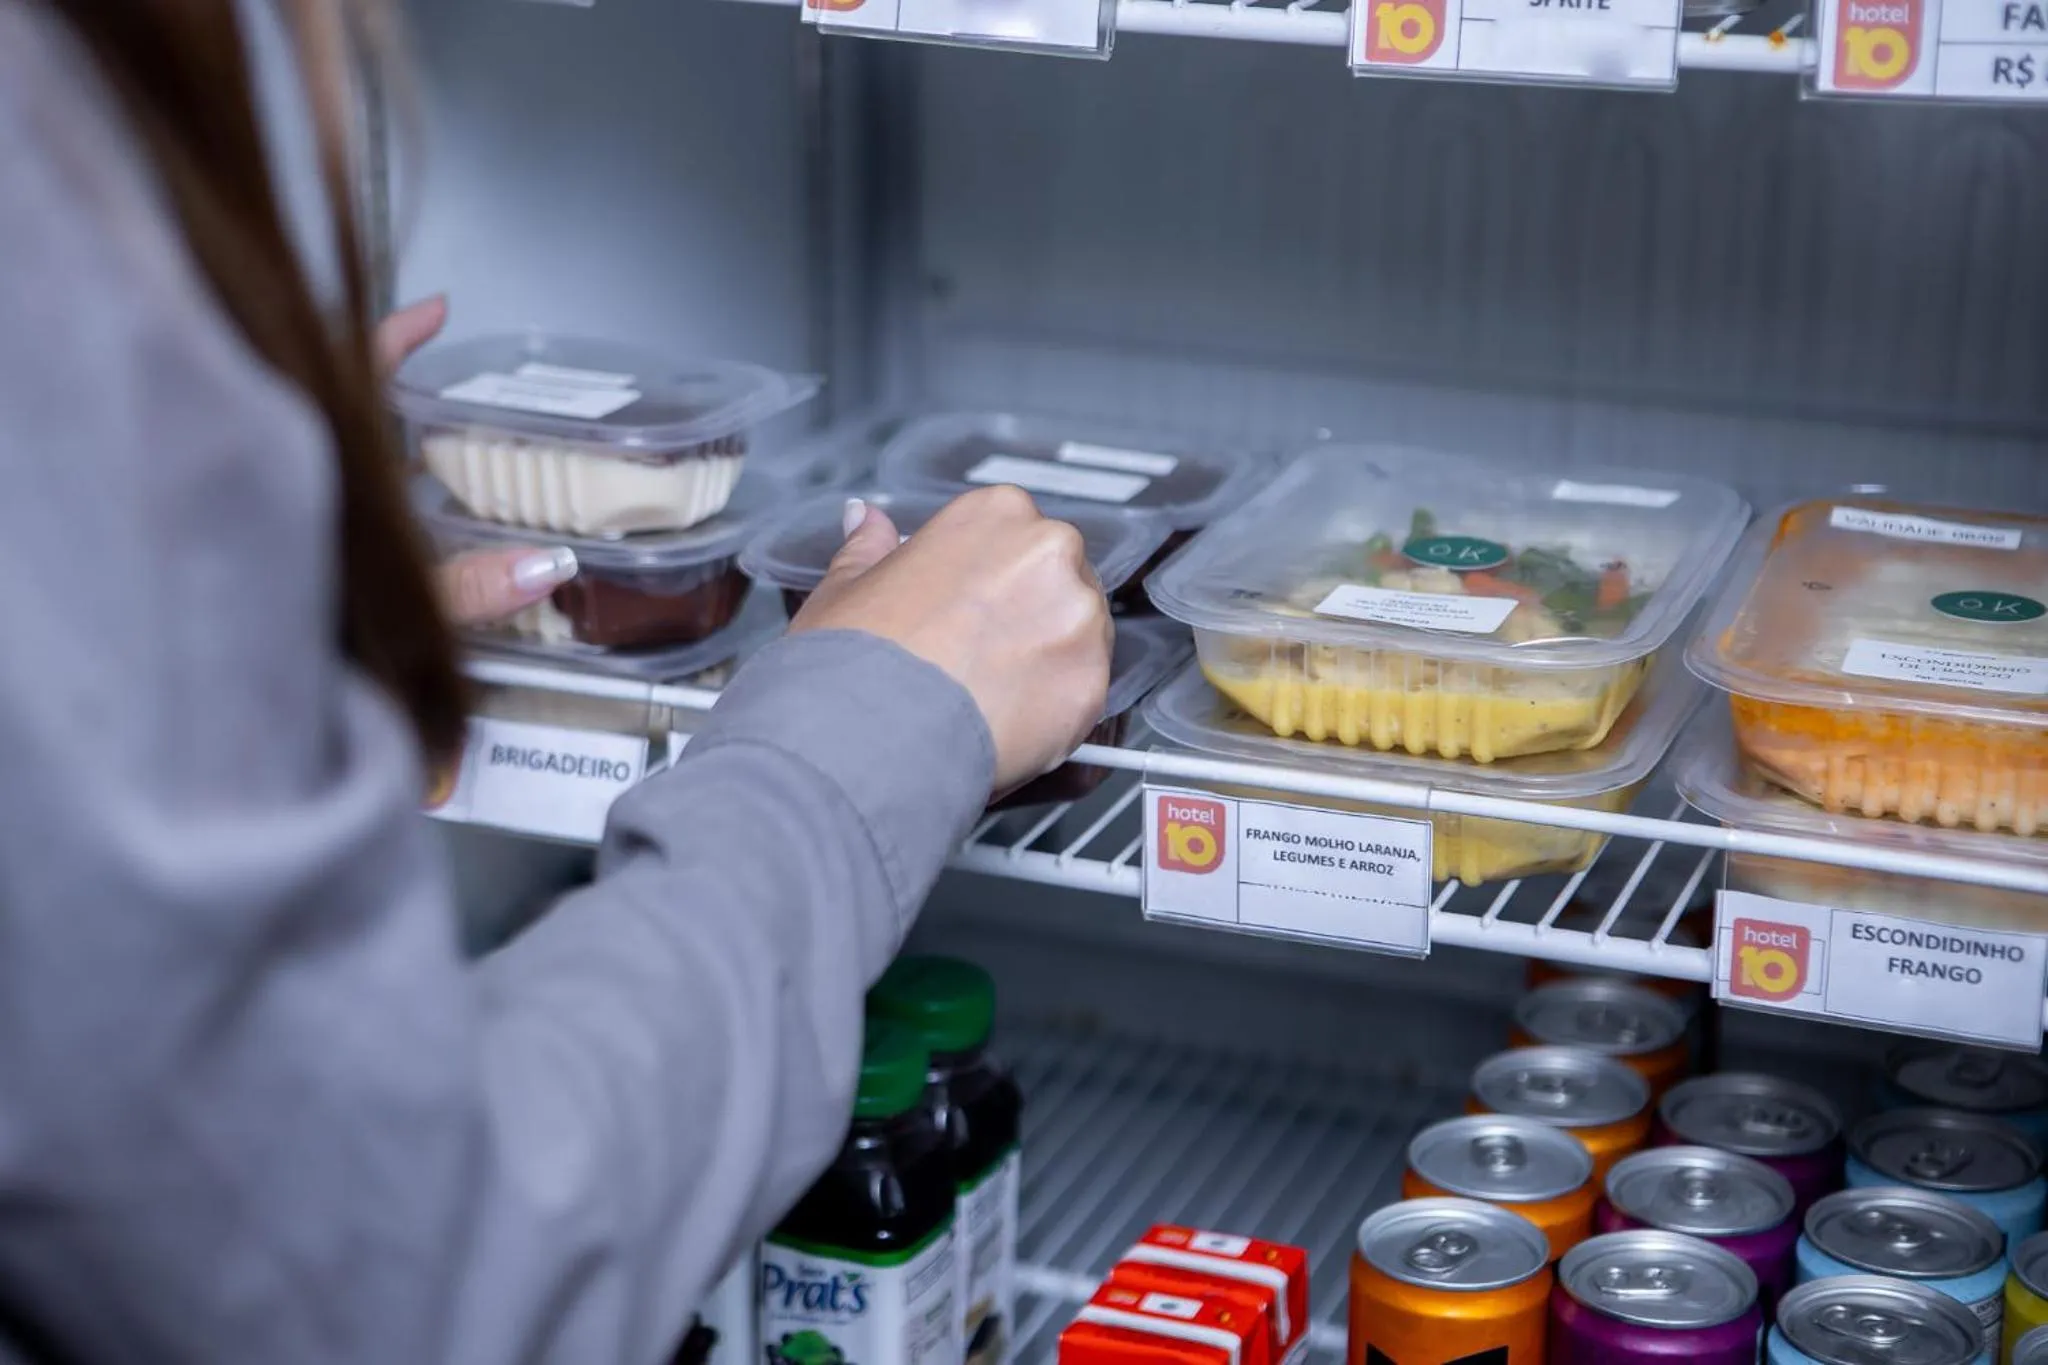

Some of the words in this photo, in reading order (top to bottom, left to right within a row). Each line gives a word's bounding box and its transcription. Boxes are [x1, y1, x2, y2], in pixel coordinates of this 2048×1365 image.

[1850, 2, 1909, 24] hotel
[2002, 4, 2048, 31] FA
[1992, 53, 2035, 89] R$
[490, 744, 631, 782] BRIGADEIRO
[1167, 803, 1216, 825] hotel
[1164, 822, 1217, 866] 10
[1246, 828, 1301, 845] FRANGO
[1304, 834, 1355, 851] MOLHO
[1358, 841, 1421, 862] LARANJA,
[1273, 850, 1335, 868] LEGUMES
[1338, 859, 1347, 869] E
[1349, 860, 1394, 876] ARROZ
[1744, 926, 1797, 949] hotel
[1851, 923, 2025, 963] ESCONDIDINHO
[1738, 946, 1798, 993] 10
[1888, 957, 1983, 985] FRANGO
